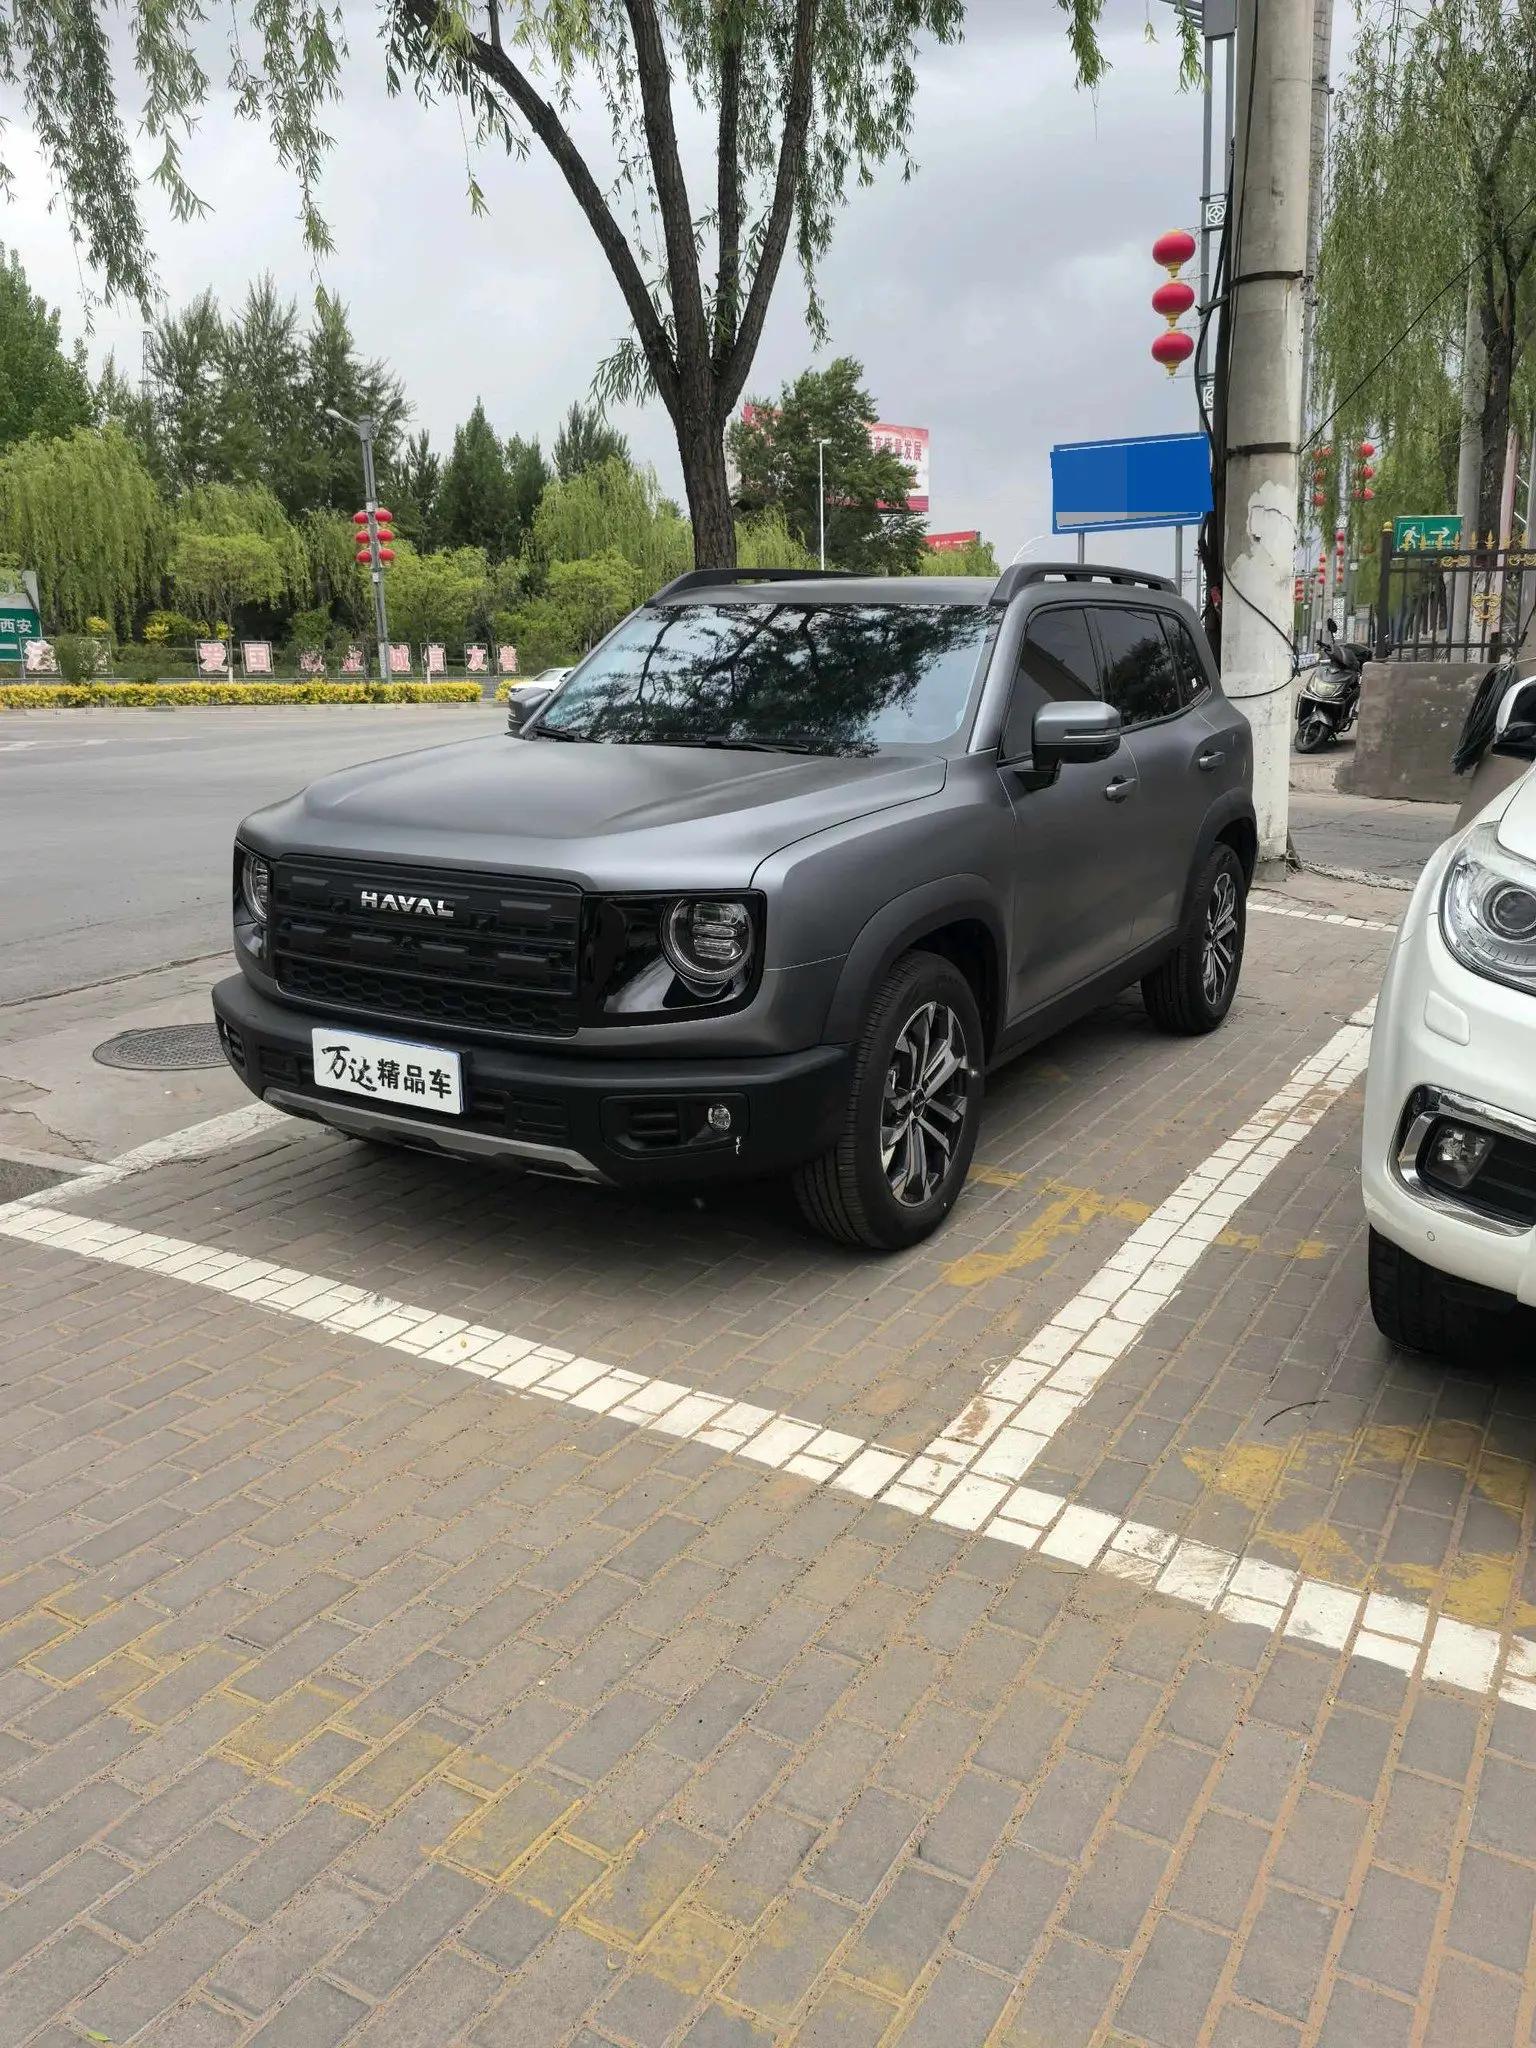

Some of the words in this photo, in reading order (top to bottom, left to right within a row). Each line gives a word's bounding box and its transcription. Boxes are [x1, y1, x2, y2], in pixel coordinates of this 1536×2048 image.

[0, 617, 32, 633] 西安
[361, 891, 454, 918] HAVAL
[321, 1046, 452, 1098] 万达精品车
